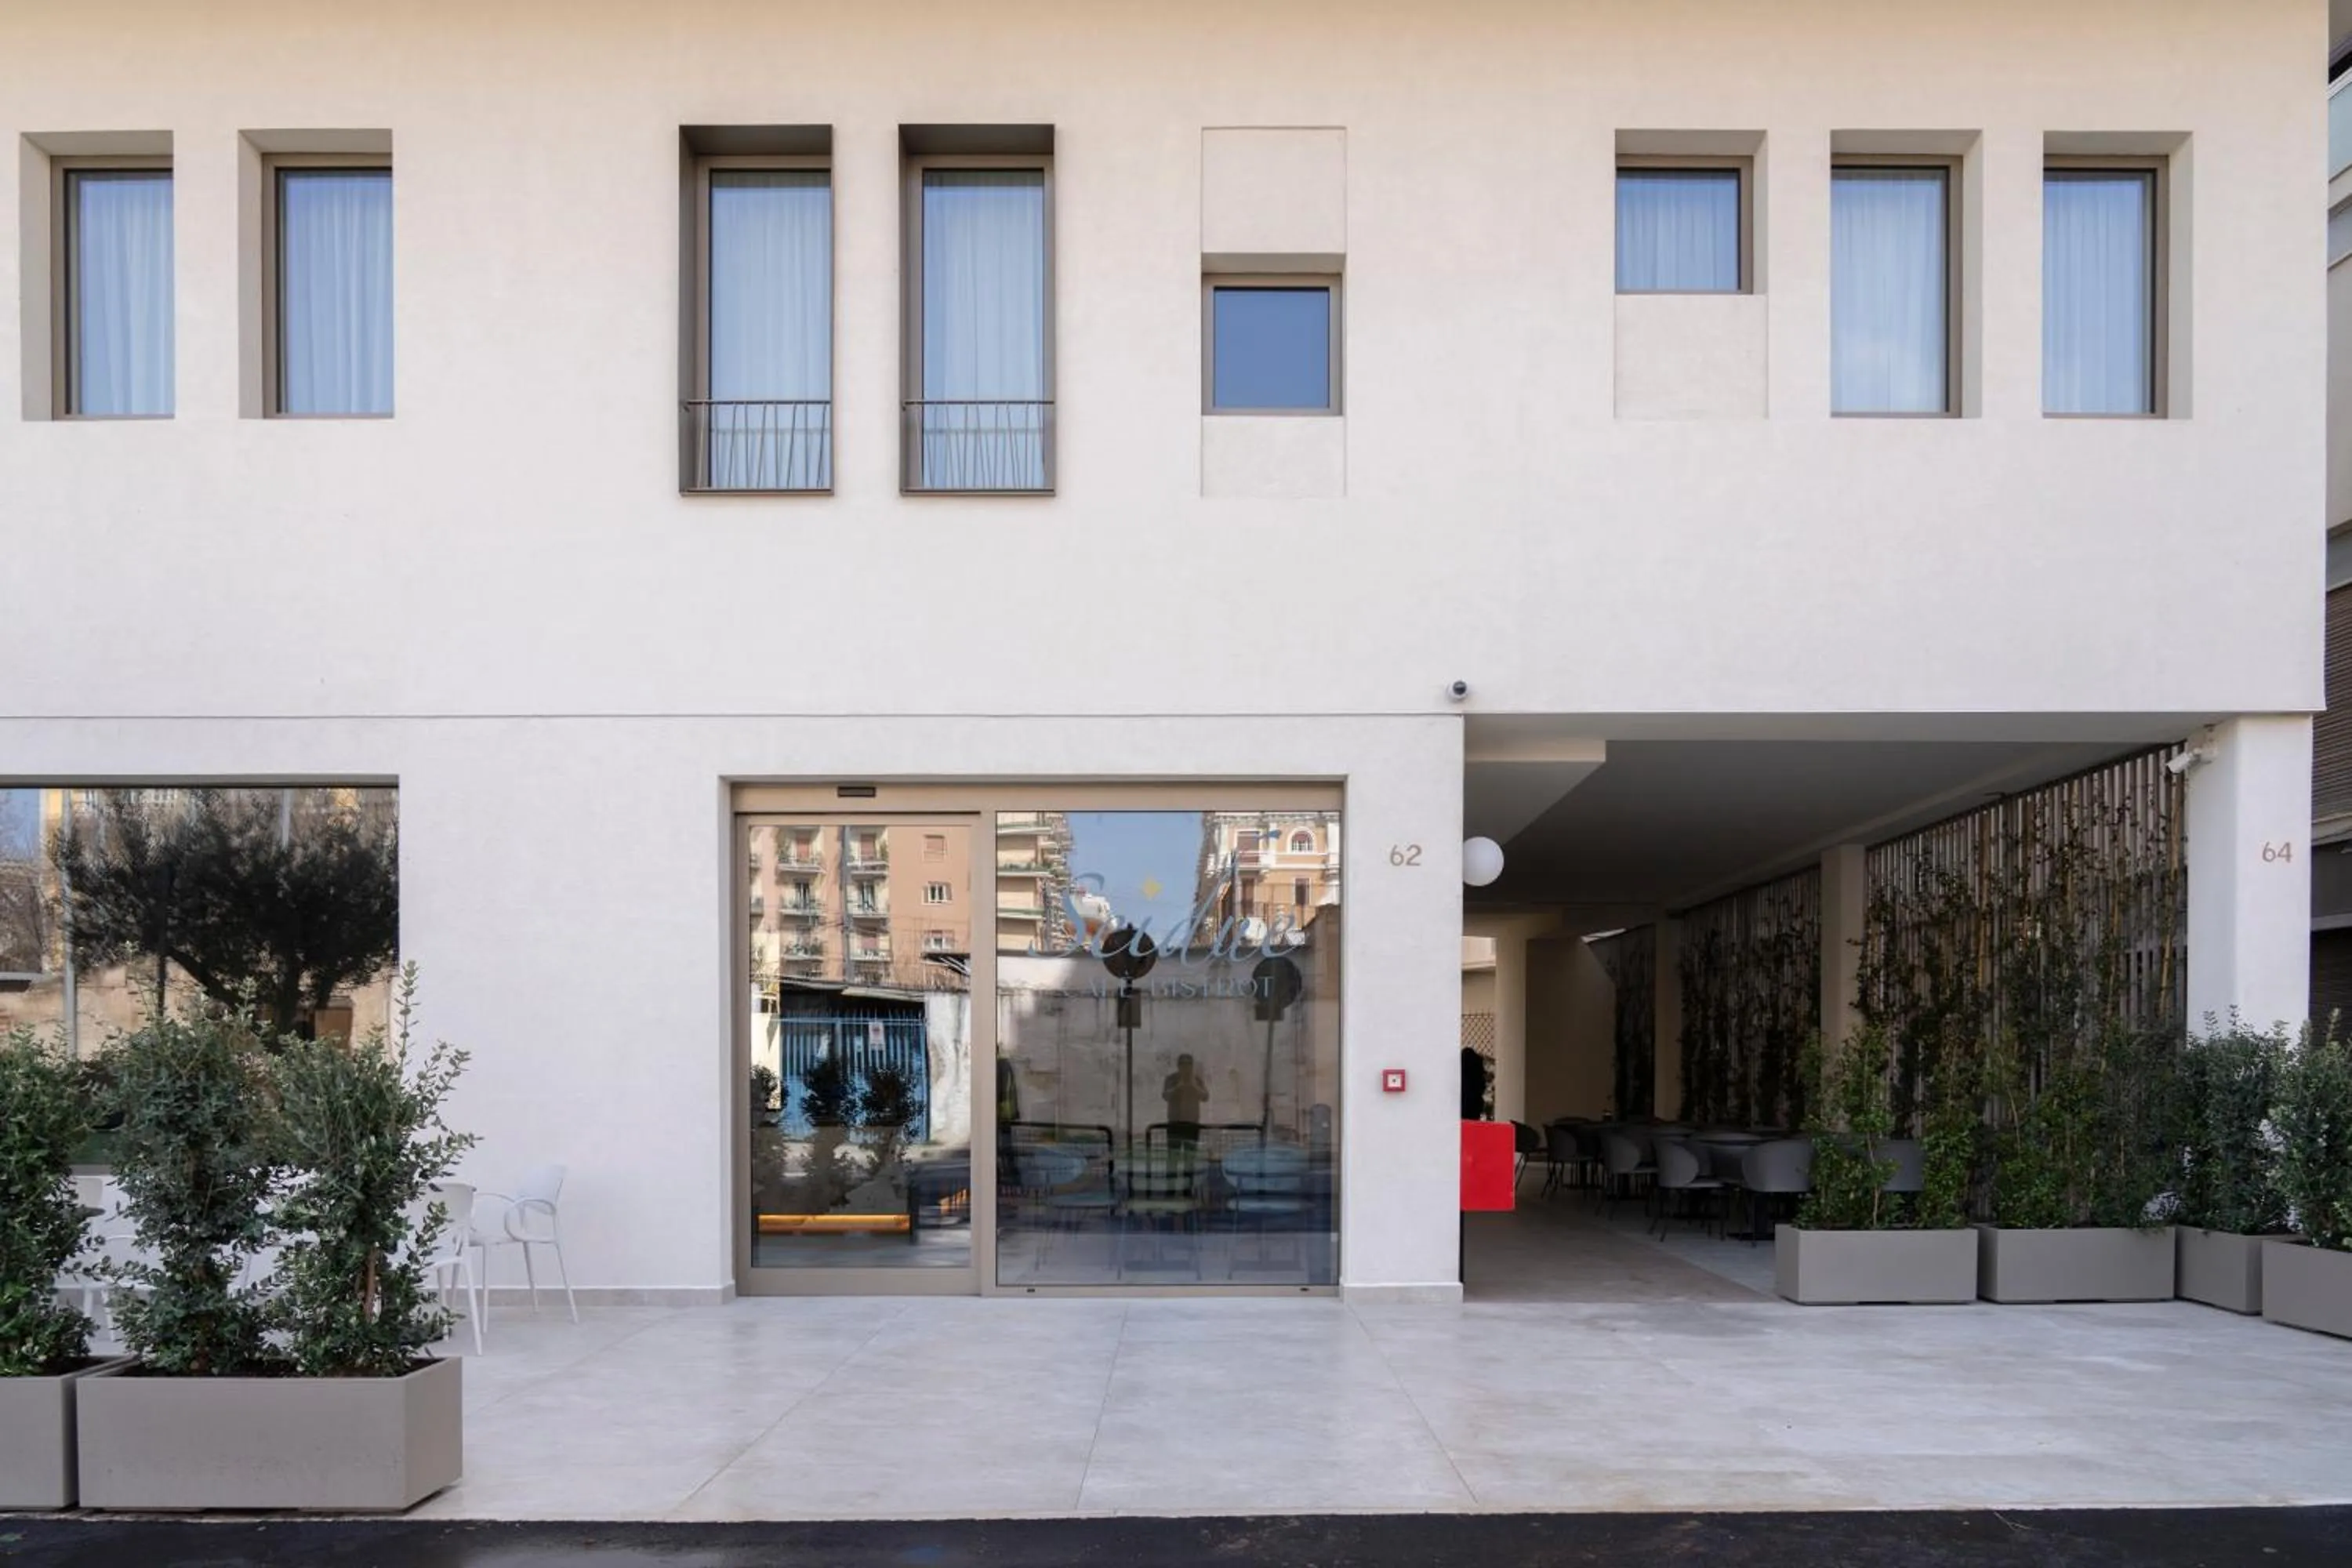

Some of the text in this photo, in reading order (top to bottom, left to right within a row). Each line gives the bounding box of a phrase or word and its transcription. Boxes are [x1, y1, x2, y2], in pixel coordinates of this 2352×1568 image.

[1389, 844, 1423, 866] 62
[2262, 841, 2292, 863] 64
[1149, 976, 1276, 999] BISTROT
